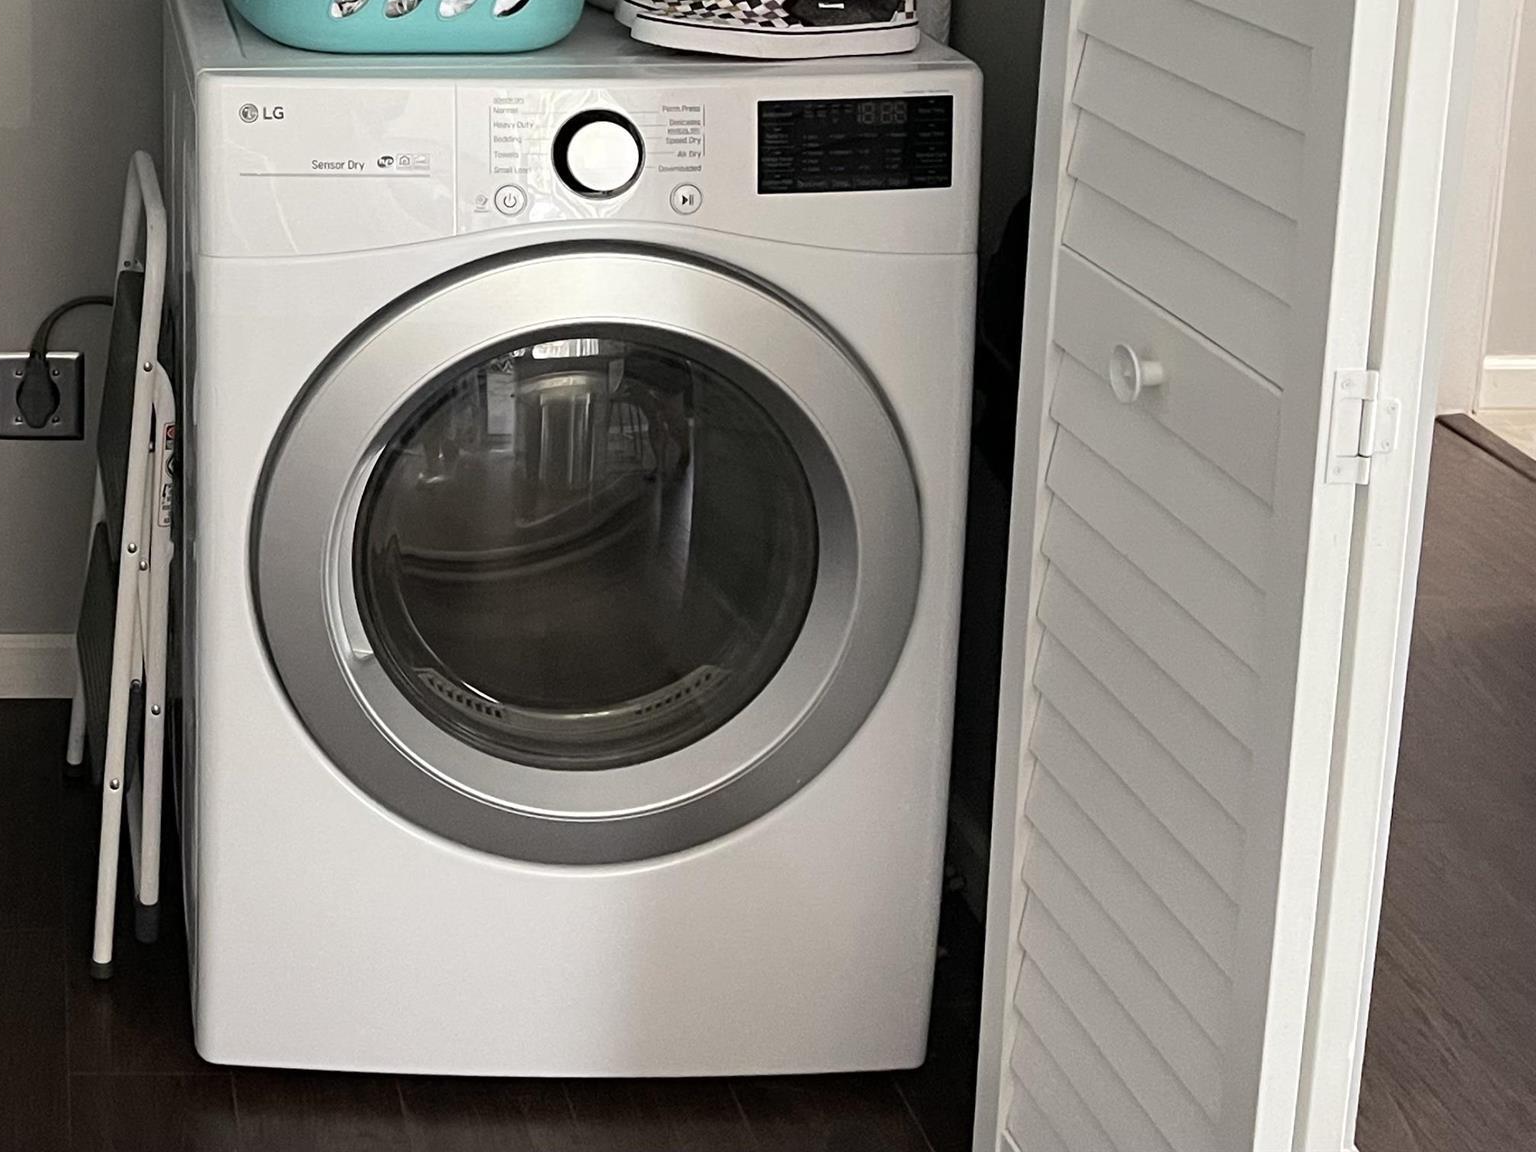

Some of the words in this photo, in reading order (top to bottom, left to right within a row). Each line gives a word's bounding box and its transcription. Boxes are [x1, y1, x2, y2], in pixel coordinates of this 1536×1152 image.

[262, 106, 285, 120] LG
[311, 159, 345, 170] Sensor
[347, 159, 365, 171] Dry
